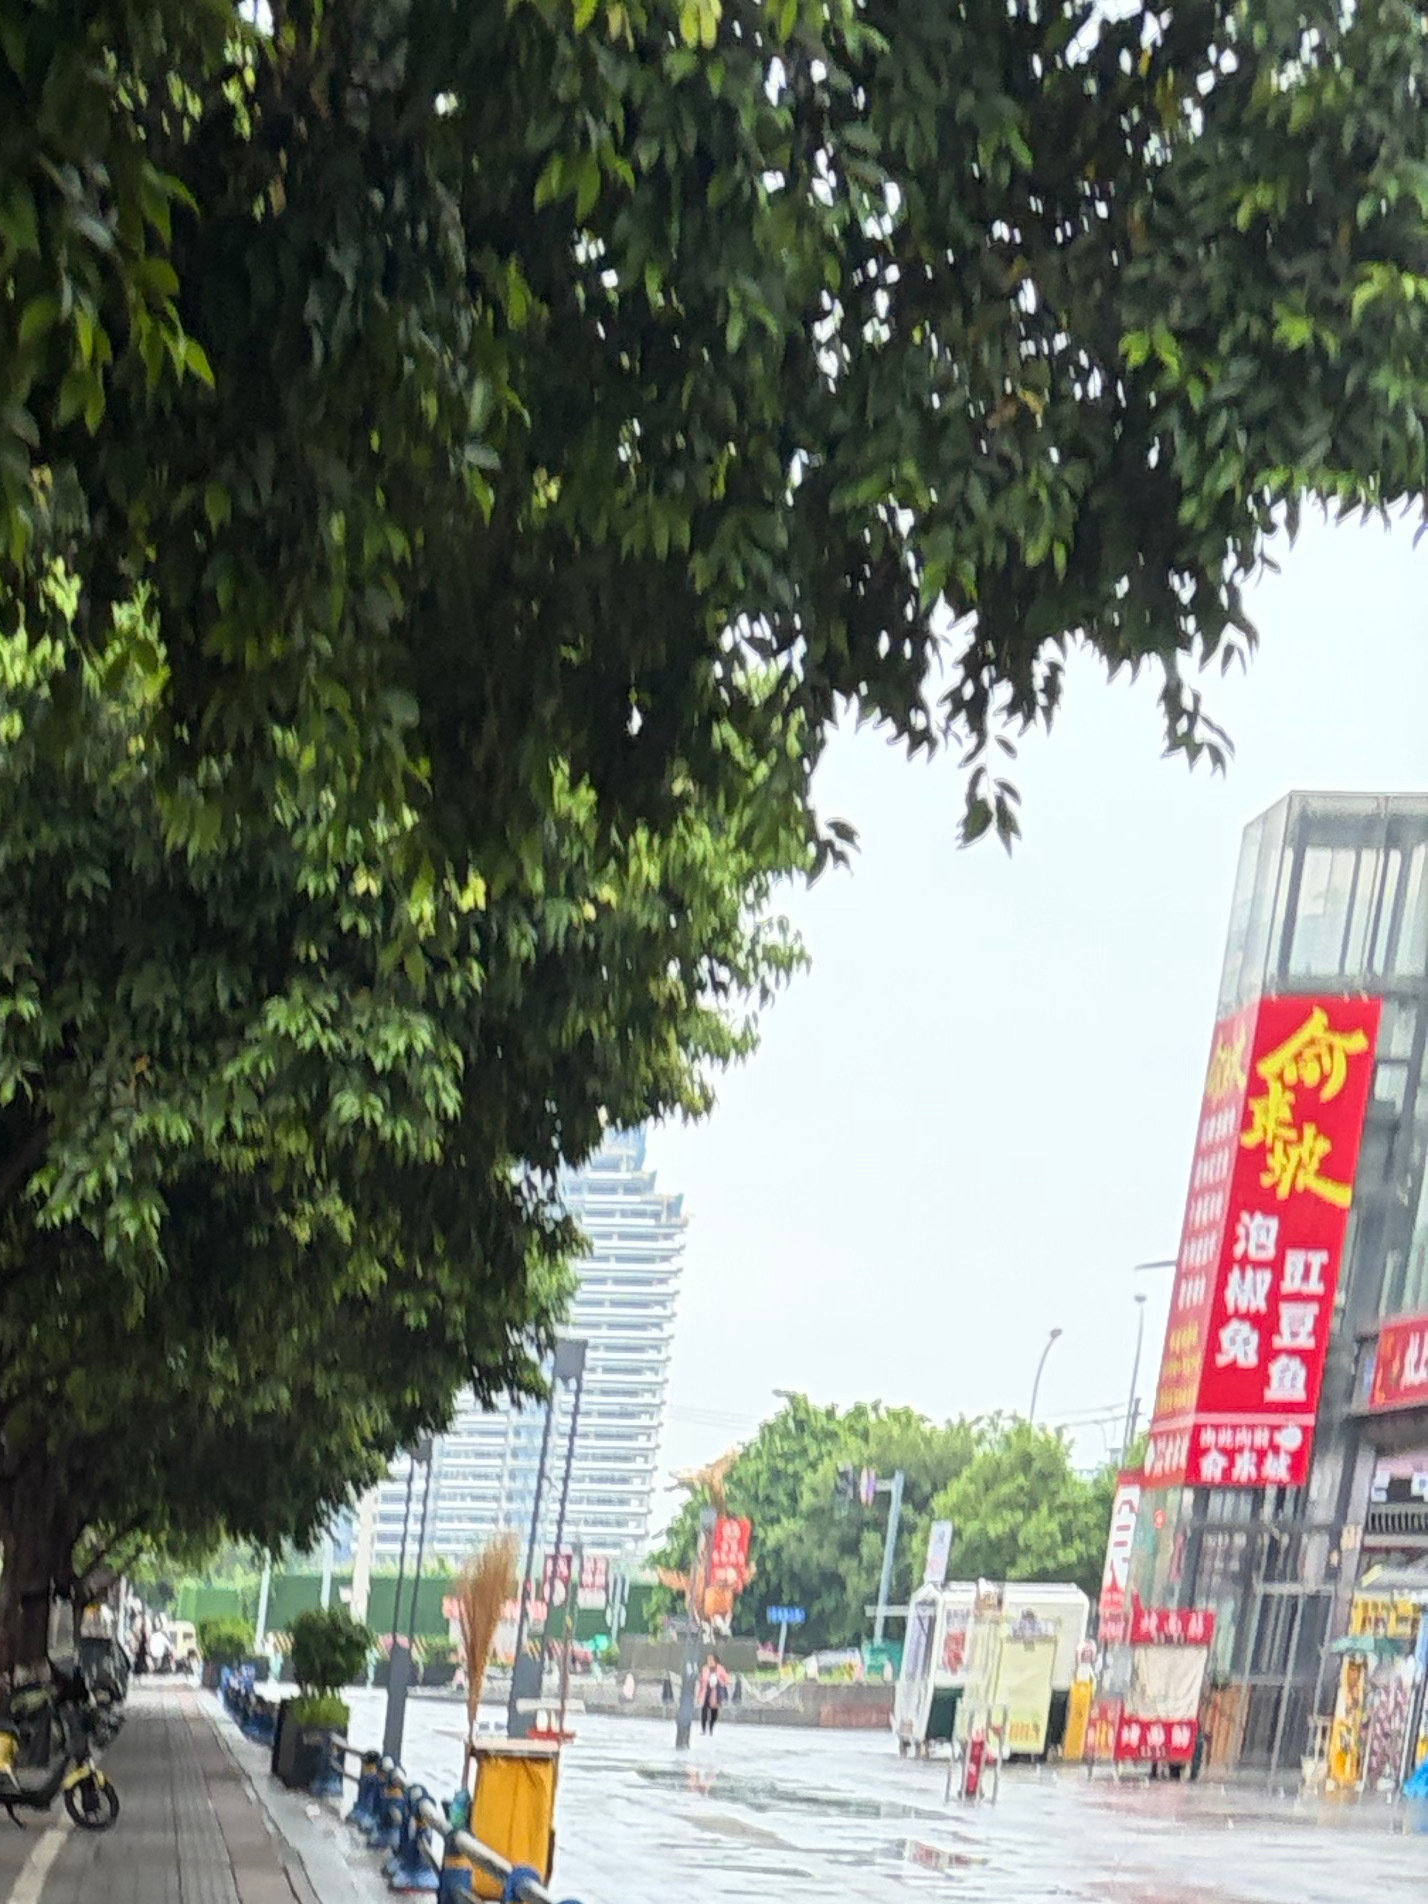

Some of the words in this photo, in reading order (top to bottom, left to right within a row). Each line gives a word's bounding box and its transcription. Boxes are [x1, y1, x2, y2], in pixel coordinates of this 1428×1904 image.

[1215, 1210, 1279, 1369] 泡椒兔
[1263, 1247, 1330, 1403] 豇豆鱼
